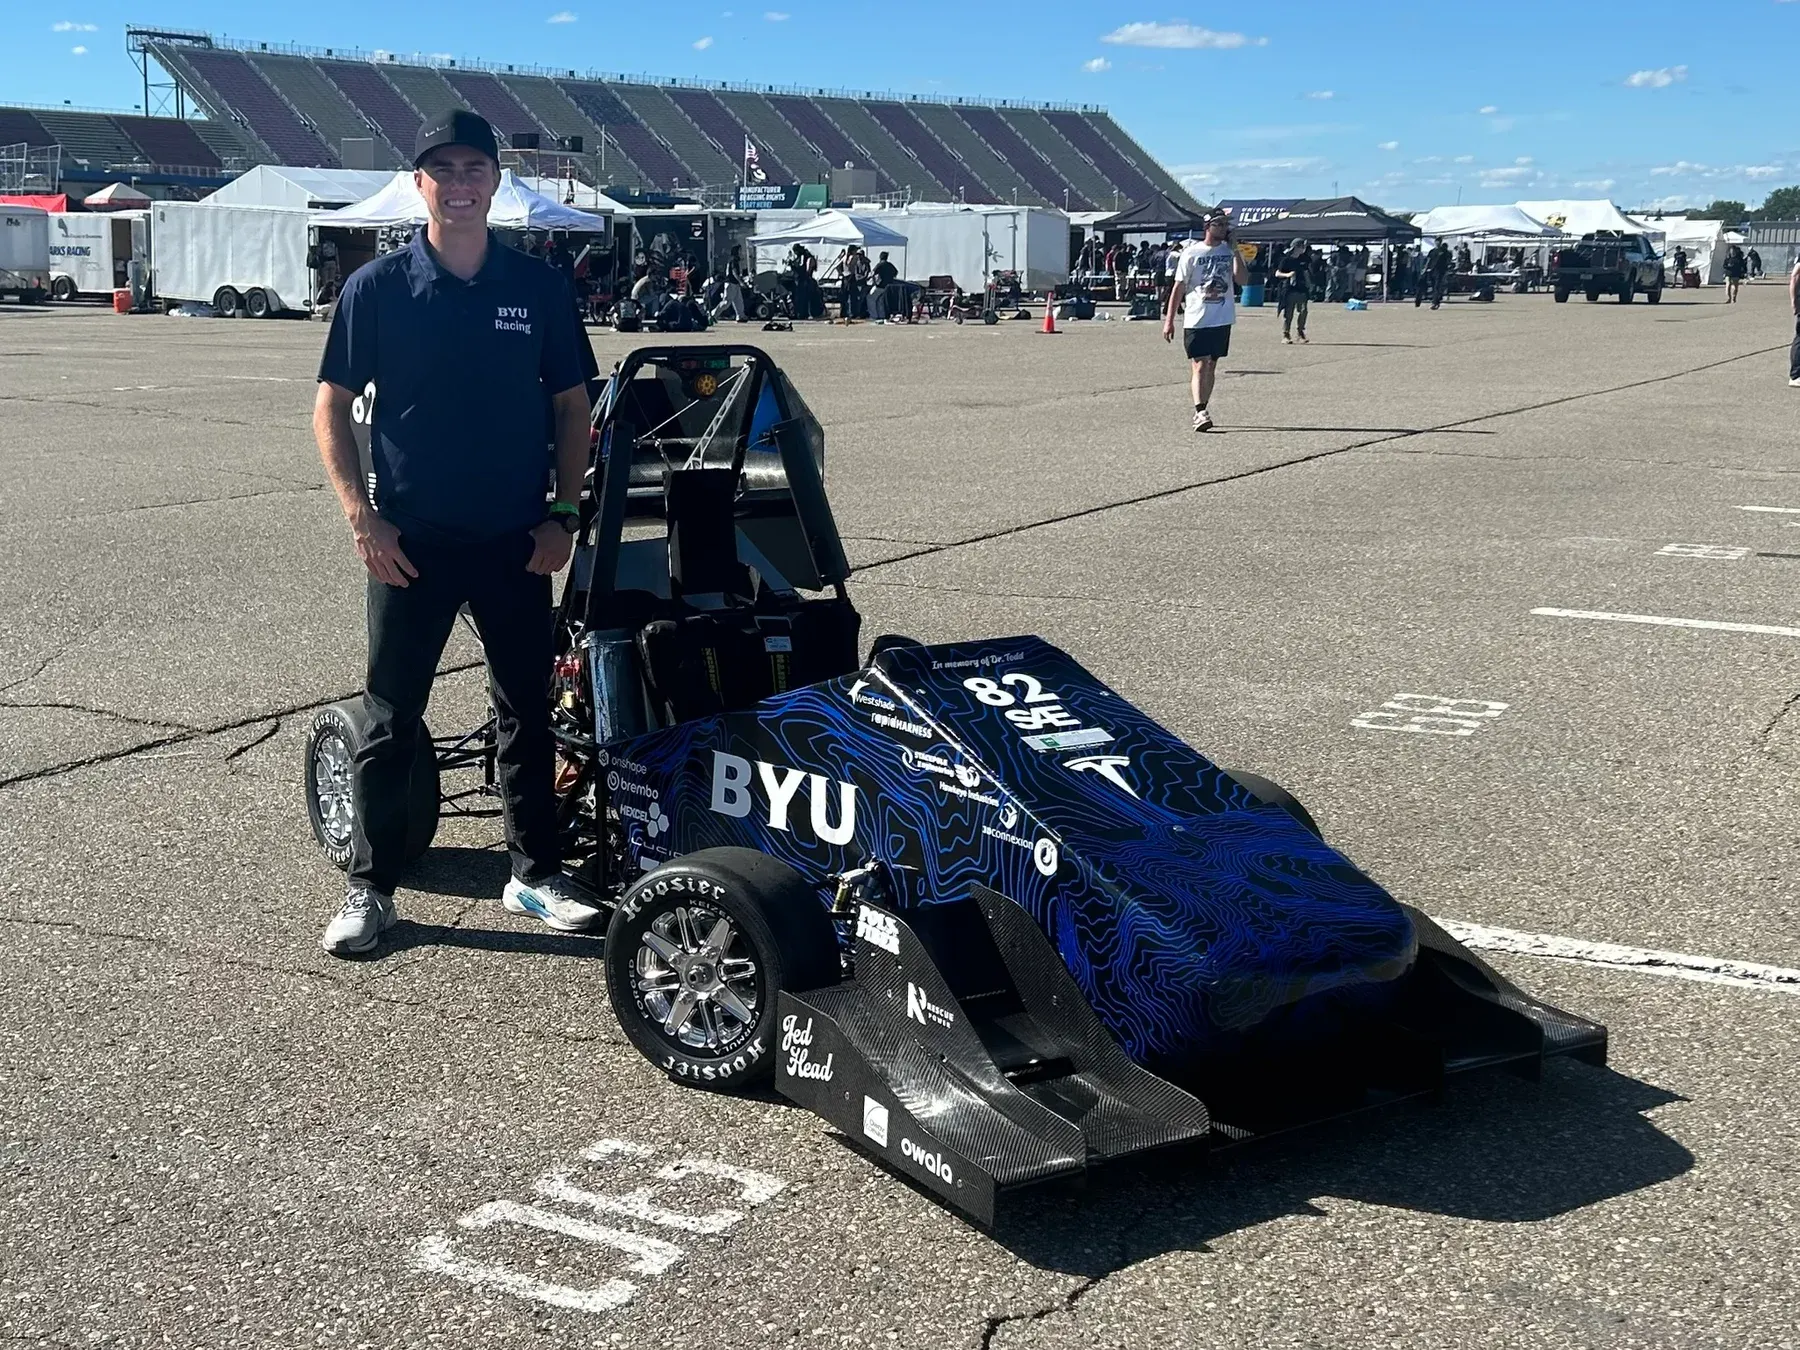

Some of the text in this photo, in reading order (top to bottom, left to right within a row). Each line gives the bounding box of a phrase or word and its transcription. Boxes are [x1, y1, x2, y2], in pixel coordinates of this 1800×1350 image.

[740, 186, 781, 194] MANUFACTURER
[740, 193, 785, 201] BRAGGING RIGHTS
[50, 245, 91, 257] ARKS RACING
[497, 307, 528, 319] BYU
[495, 319, 532, 335] Racing
[931, 651, 1025, 669] In memory of Dr. Todd
[963, 673, 1060, 707] 82
[1004, 704, 1082, 730] SAE
[611, 756, 648, 775] onshape
[620, 777, 659, 800] brembo
[708, 750, 859, 846] BYU
[620, 803, 650, 822] HEXCEL
[926, 1002, 954, 1022] RESCUE
[928, 1012, 951, 1029] POWER
[713, 1011, 760, 1055] FORMULA
[782, 1014, 813, 1052] Jed
[786, 1047, 833, 1083] Head
[901, 1137, 953, 1185] owala
